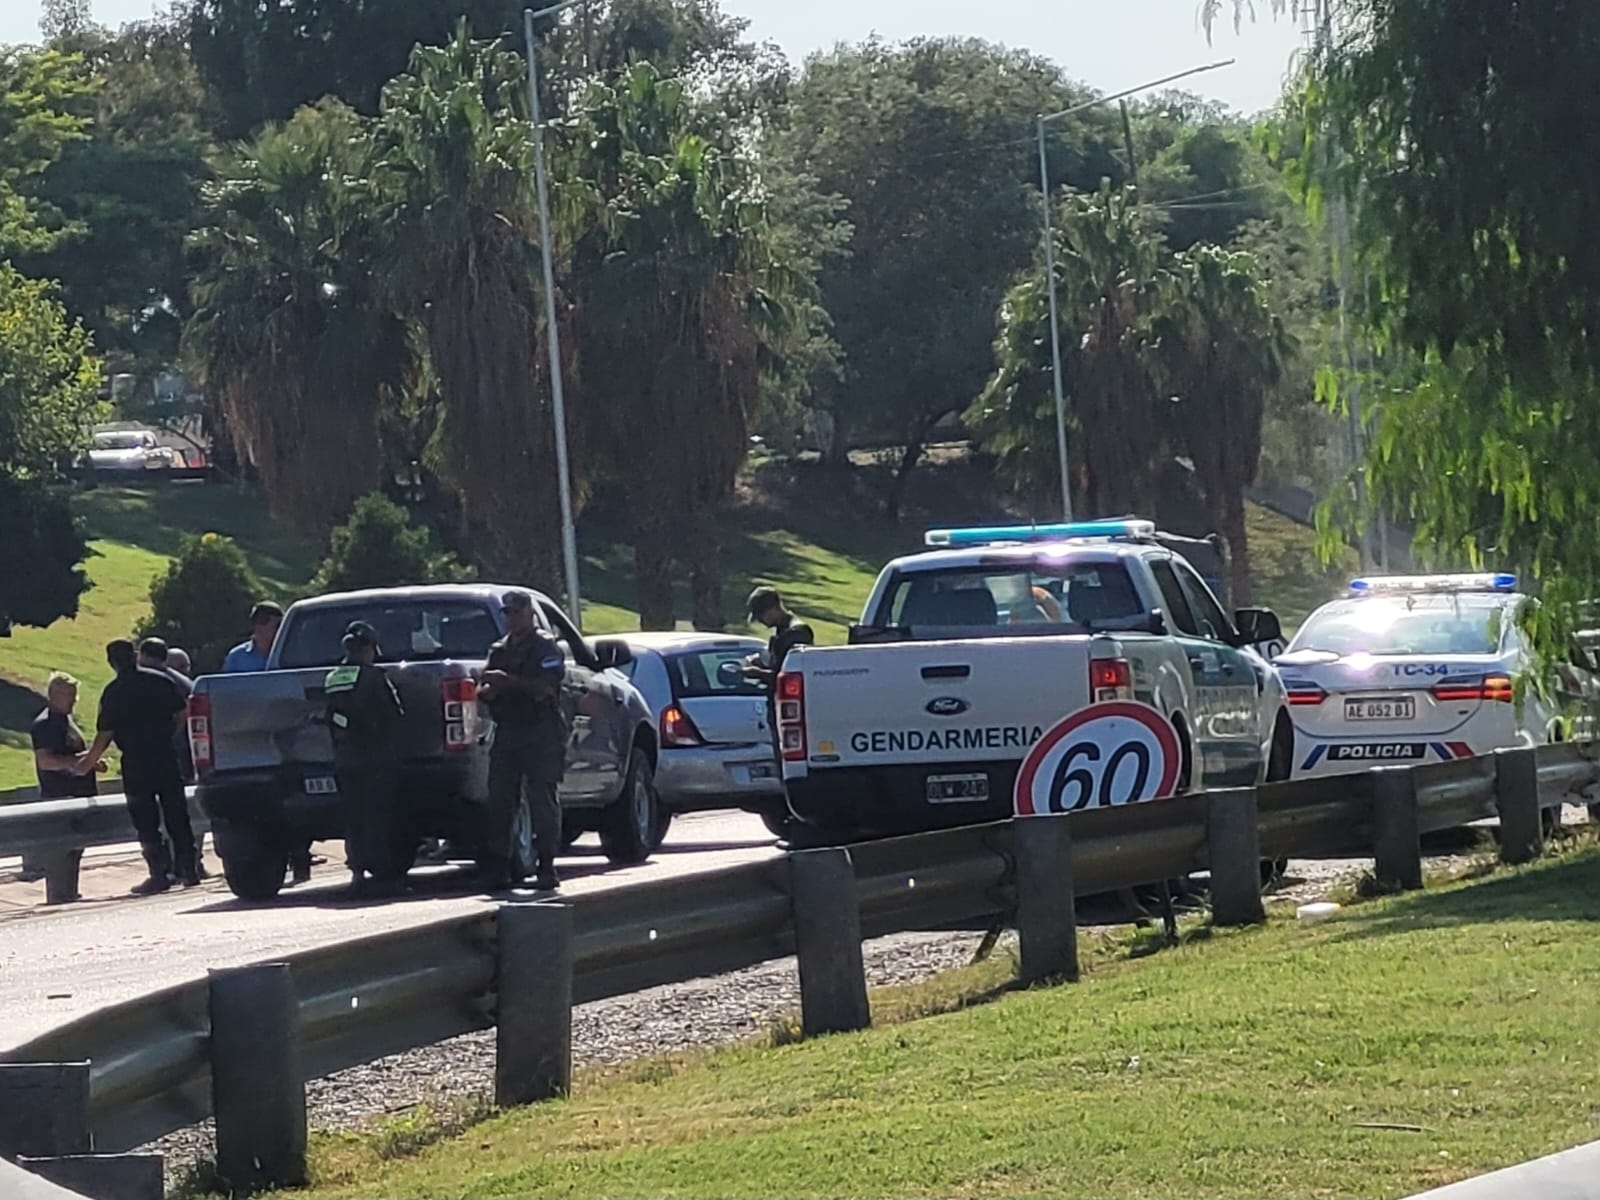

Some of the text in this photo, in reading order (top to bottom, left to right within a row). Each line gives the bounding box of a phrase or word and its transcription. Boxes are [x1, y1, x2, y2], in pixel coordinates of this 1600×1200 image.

[1393, 663, 1449, 676] TC-34
[1348, 704, 1364, 718] AE
[850, 725, 1045, 753] GENDARMERIA
[1050, 741, 1150, 813] 60
